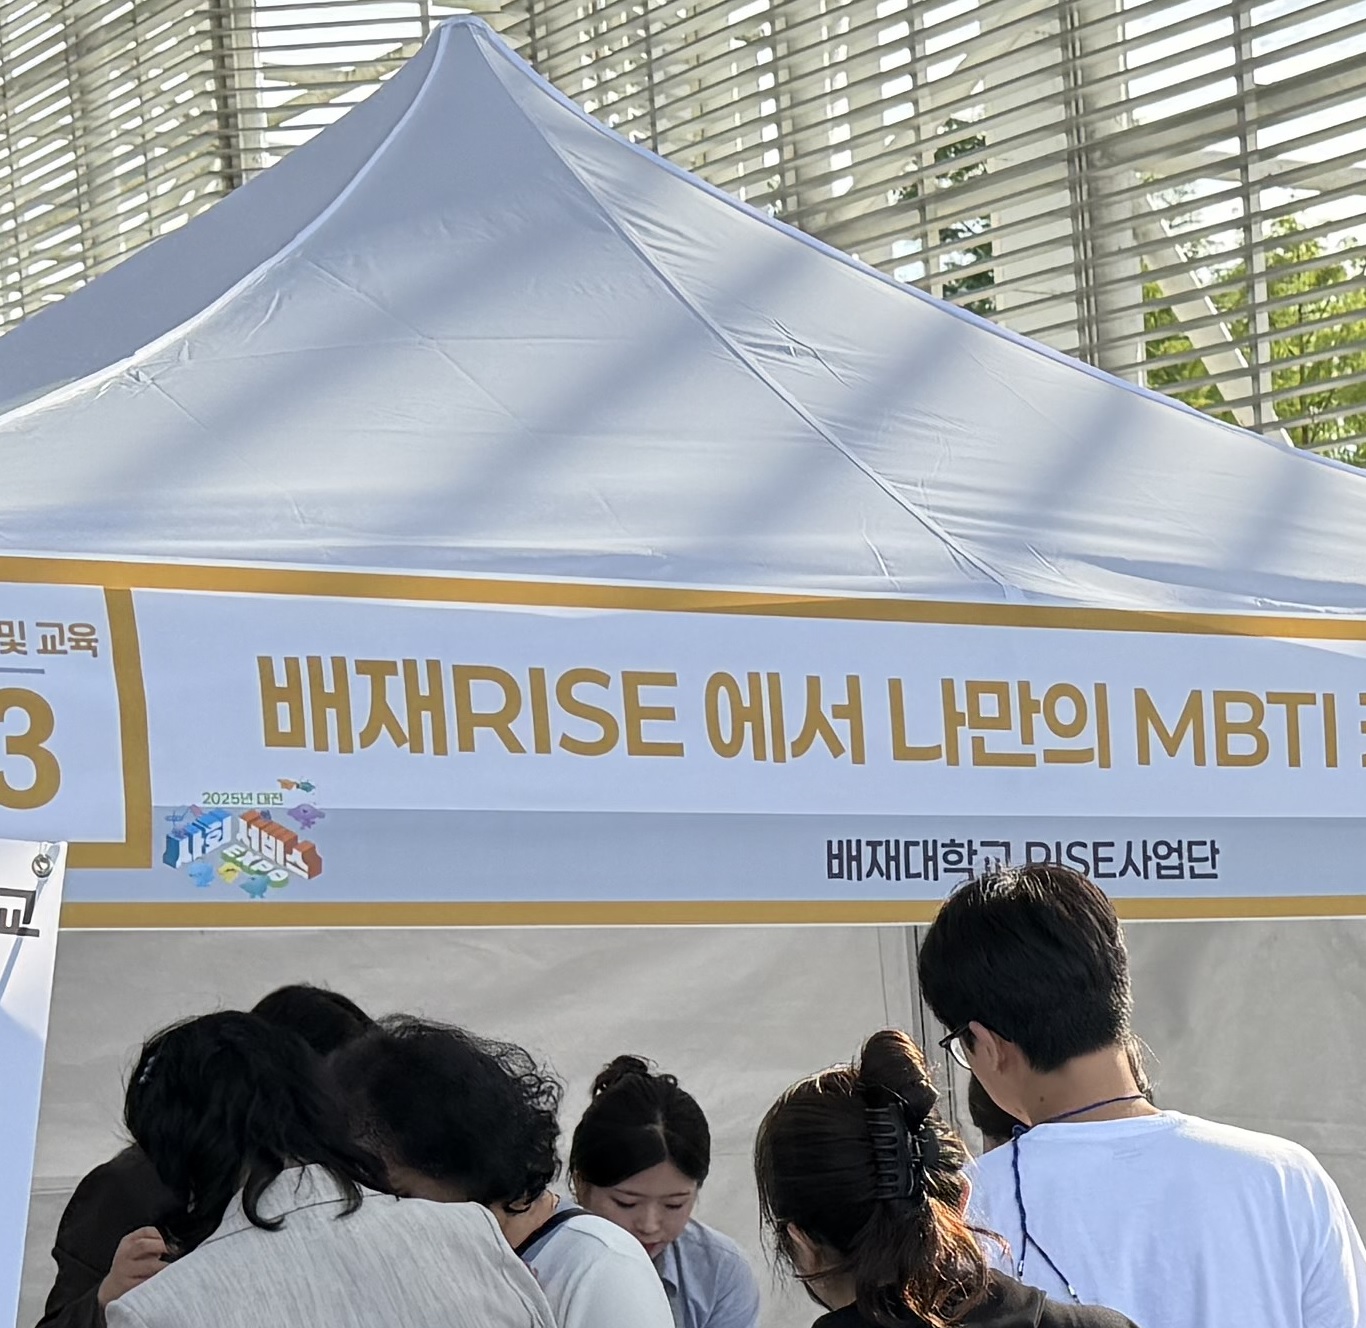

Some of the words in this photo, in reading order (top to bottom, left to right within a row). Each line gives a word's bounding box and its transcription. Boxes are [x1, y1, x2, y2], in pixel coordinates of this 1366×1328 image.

[35, 621, 98, 658] 교육
[256, 654, 685, 758] 배재RISE
[704, 670, 866, 765] 에서
[887, 677, 1112, 769] 나만의
[1133, 687, 1338, 769] MBTI
[0, 686, 61, 810] 3
[202, 791, 253, 806] 2025년
[256, 791, 285, 806] 대전
[221, 843, 289, 888] EXPO
